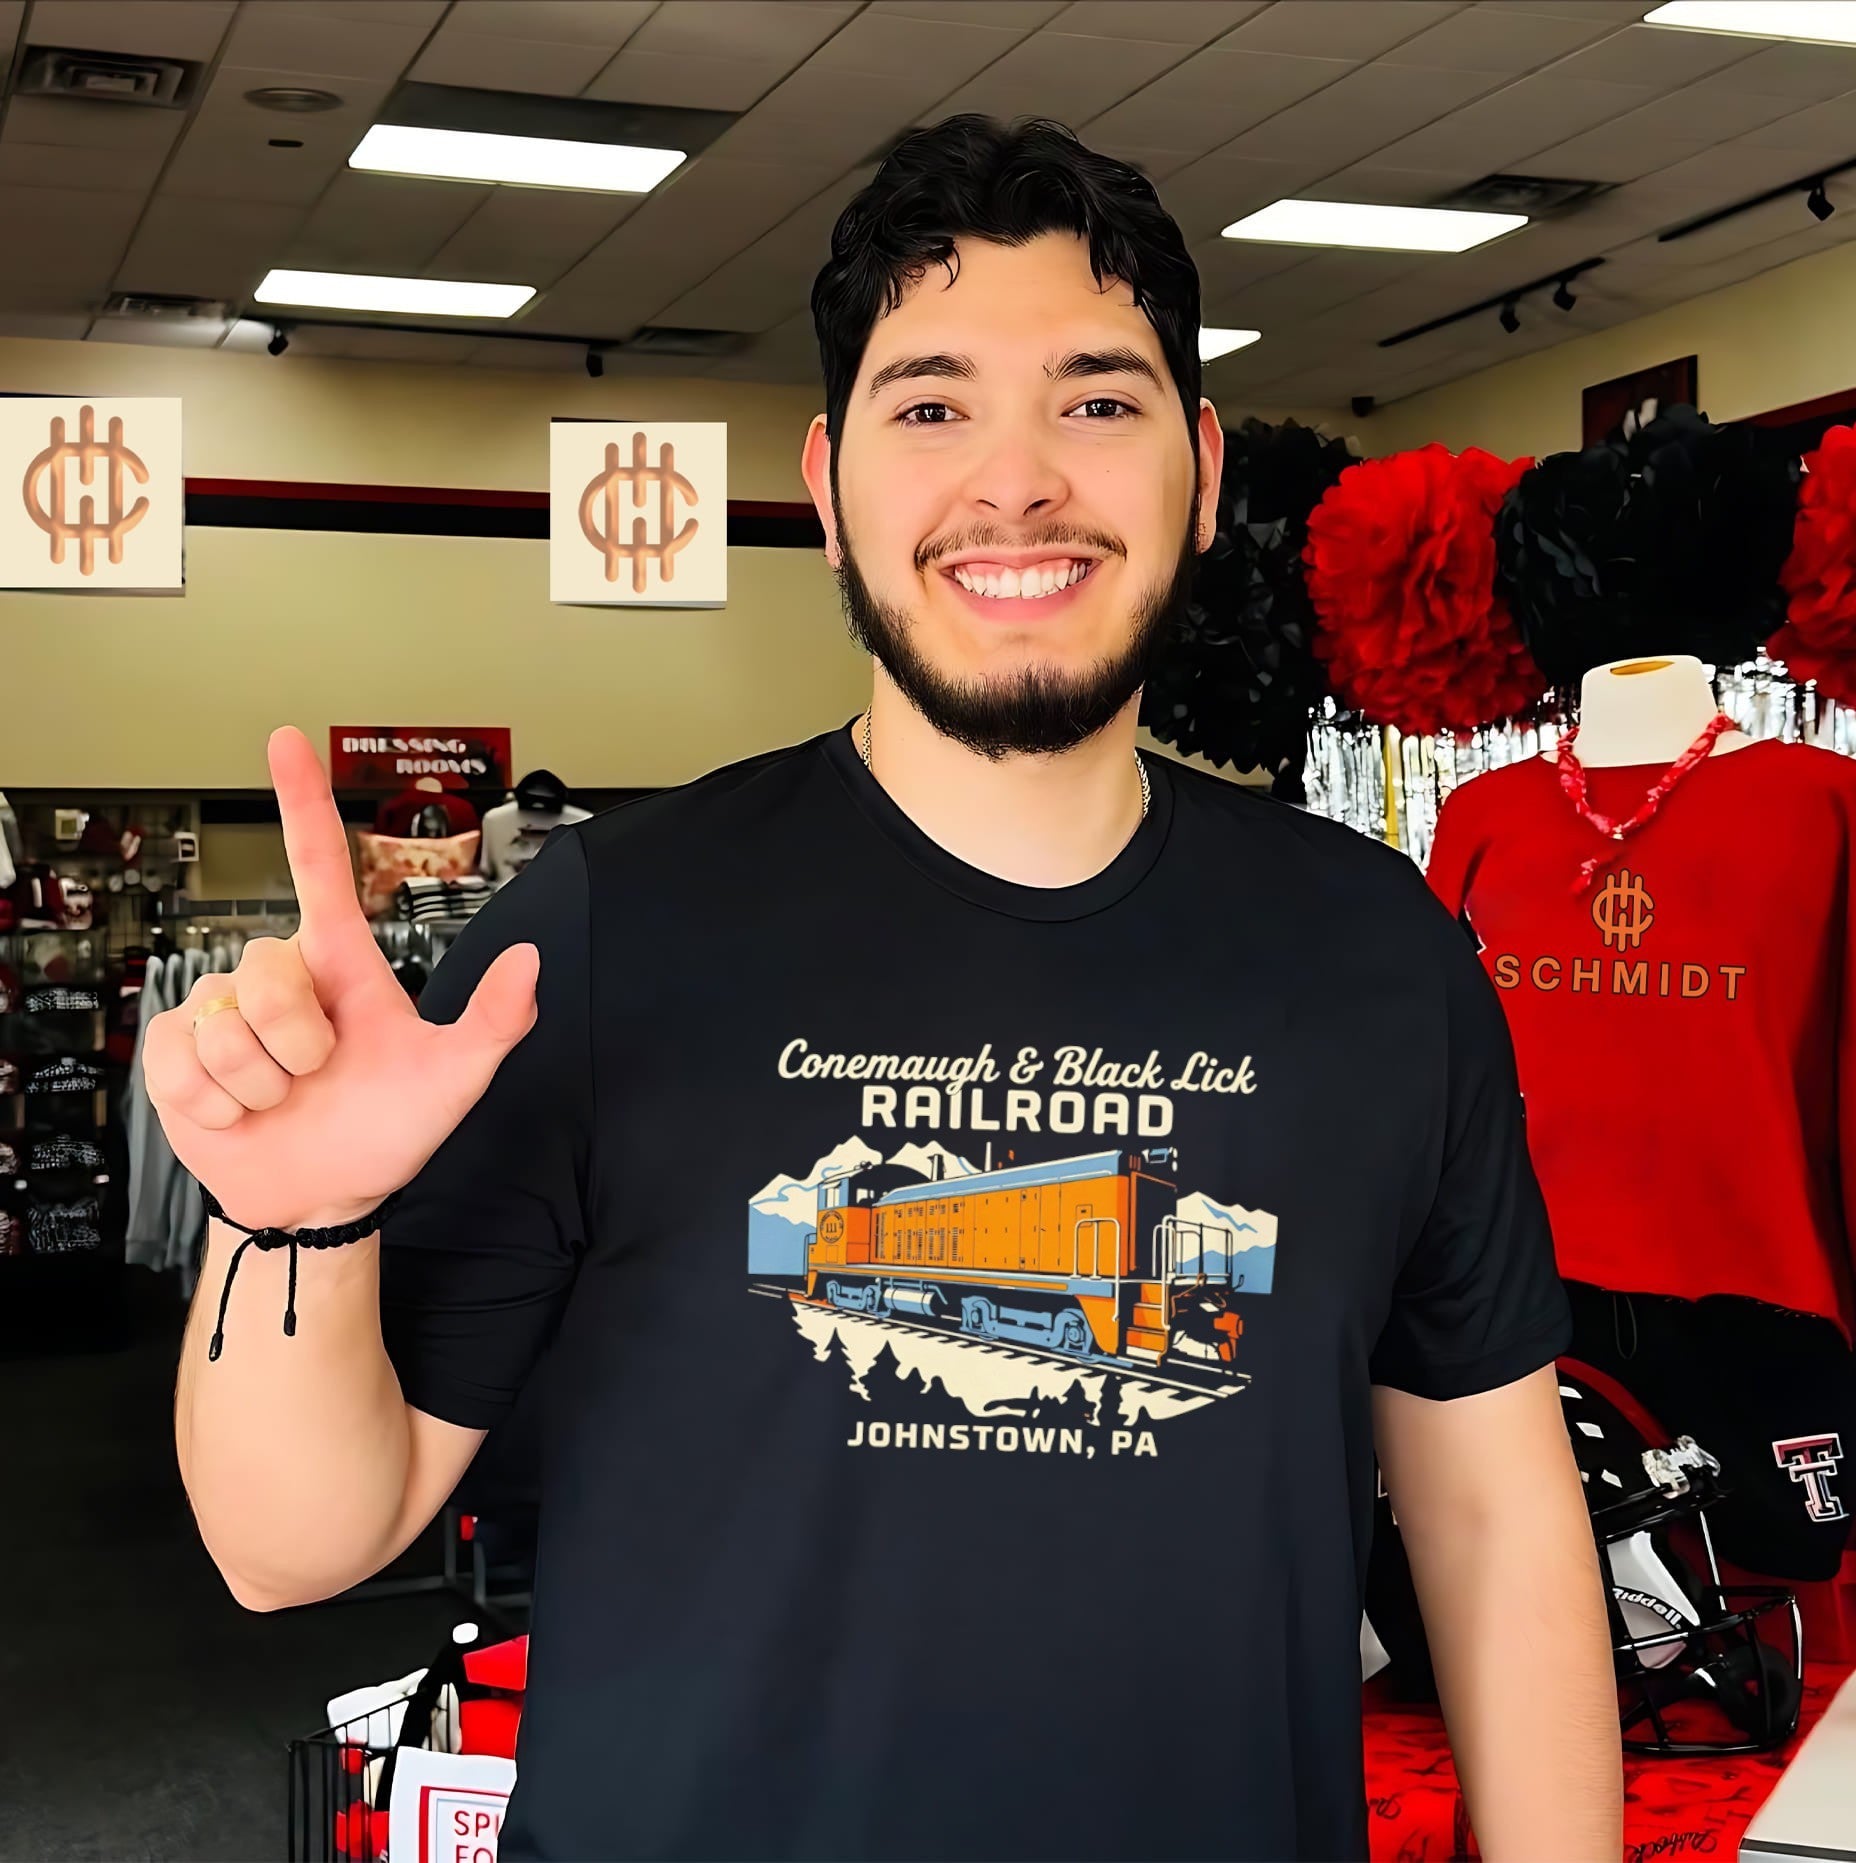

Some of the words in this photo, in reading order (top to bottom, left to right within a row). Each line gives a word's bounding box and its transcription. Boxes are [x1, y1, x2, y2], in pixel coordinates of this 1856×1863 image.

[342, 737, 467, 753] DRESSING
[396, 758, 487, 774] ROOMS
[1494, 955, 1746, 1000] SCHMIDT
[777, 1038, 1000, 1095] Conemaugh
[1009, 1045, 1045, 1085] &
[1053, 1045, 1165, 1089] Black
[1170, 1051, 1258, 1095] Lick
[861, 1085, 1174, 1137] RAILROAD
[847, 1421, 1096, 1460] JOHNSTOWN,
[1111, 1430, 1159, 1457] PA
